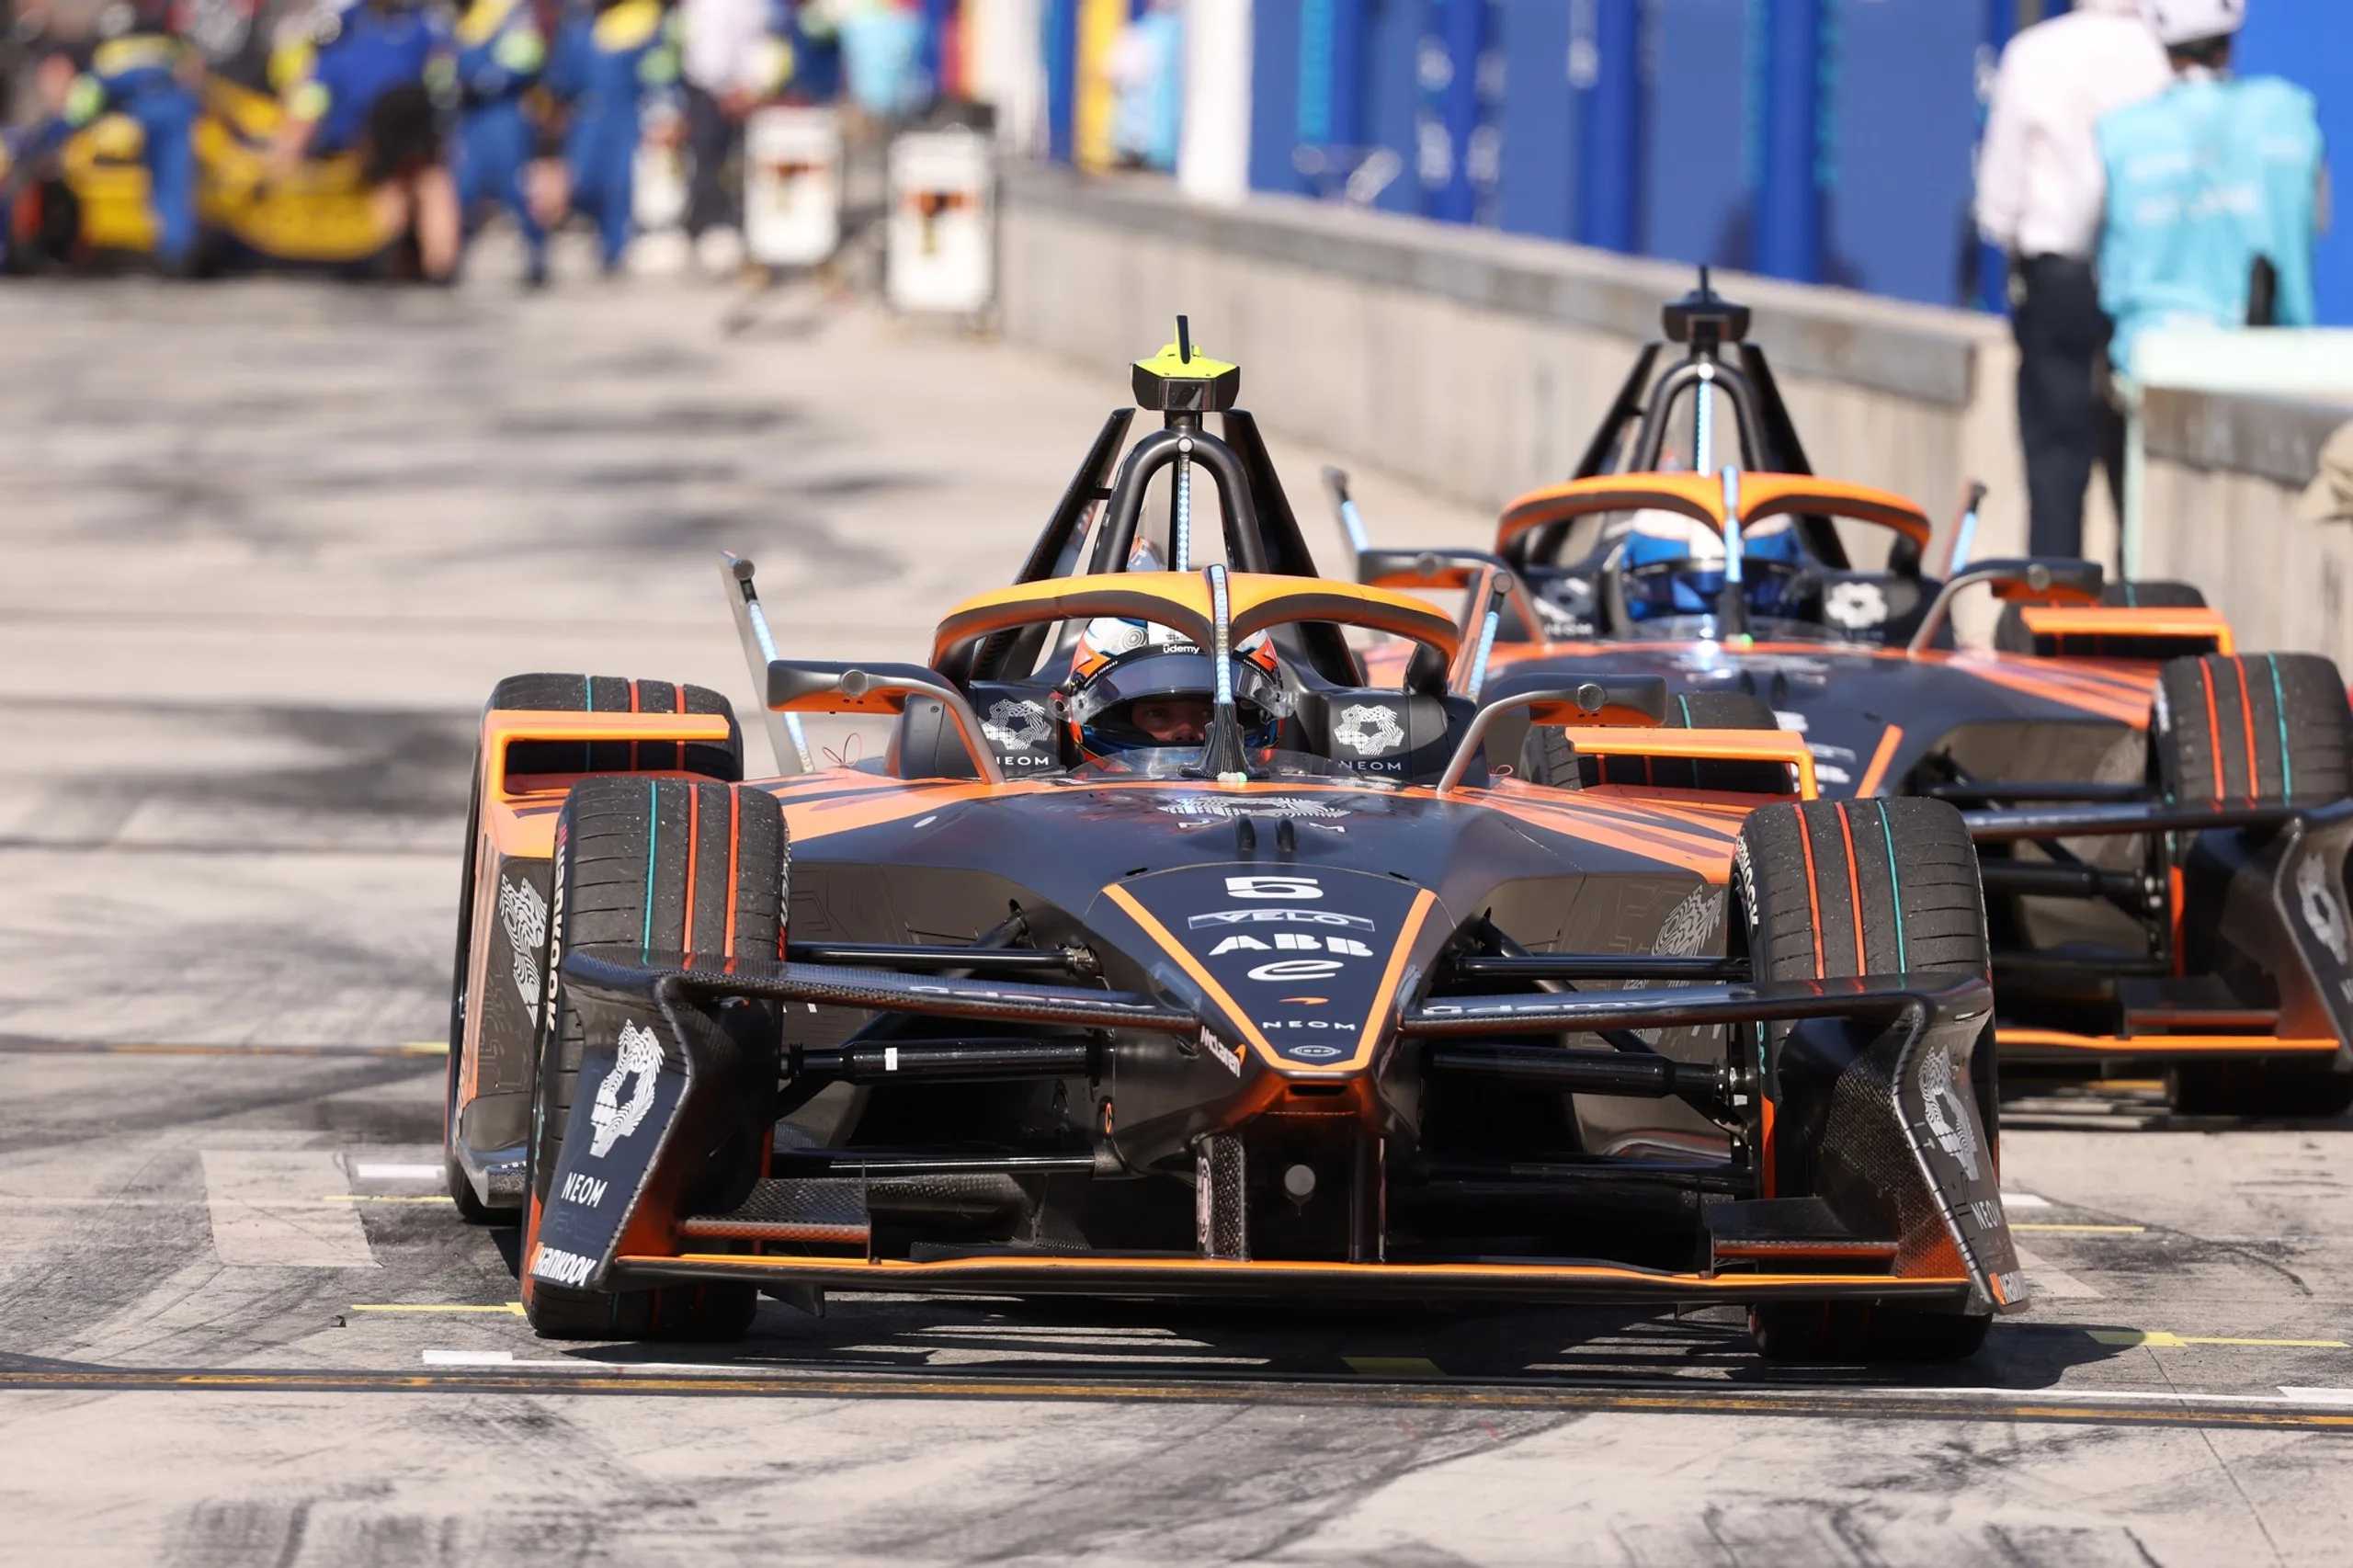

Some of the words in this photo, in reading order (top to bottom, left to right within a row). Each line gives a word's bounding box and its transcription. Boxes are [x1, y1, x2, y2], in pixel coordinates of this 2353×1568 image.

[995, 756, 1049, 766] EOM
[1338, 760, 1402, 770] NEOM
[1224, 876, 1324, 899] 5
[1213, 910, 1350, 926] VELO
[1209, 933, 1374, 957] ABB
[1262, 1020, 1357, 1031] NEOM
[561, 1171, 608, 1209] NEOM
